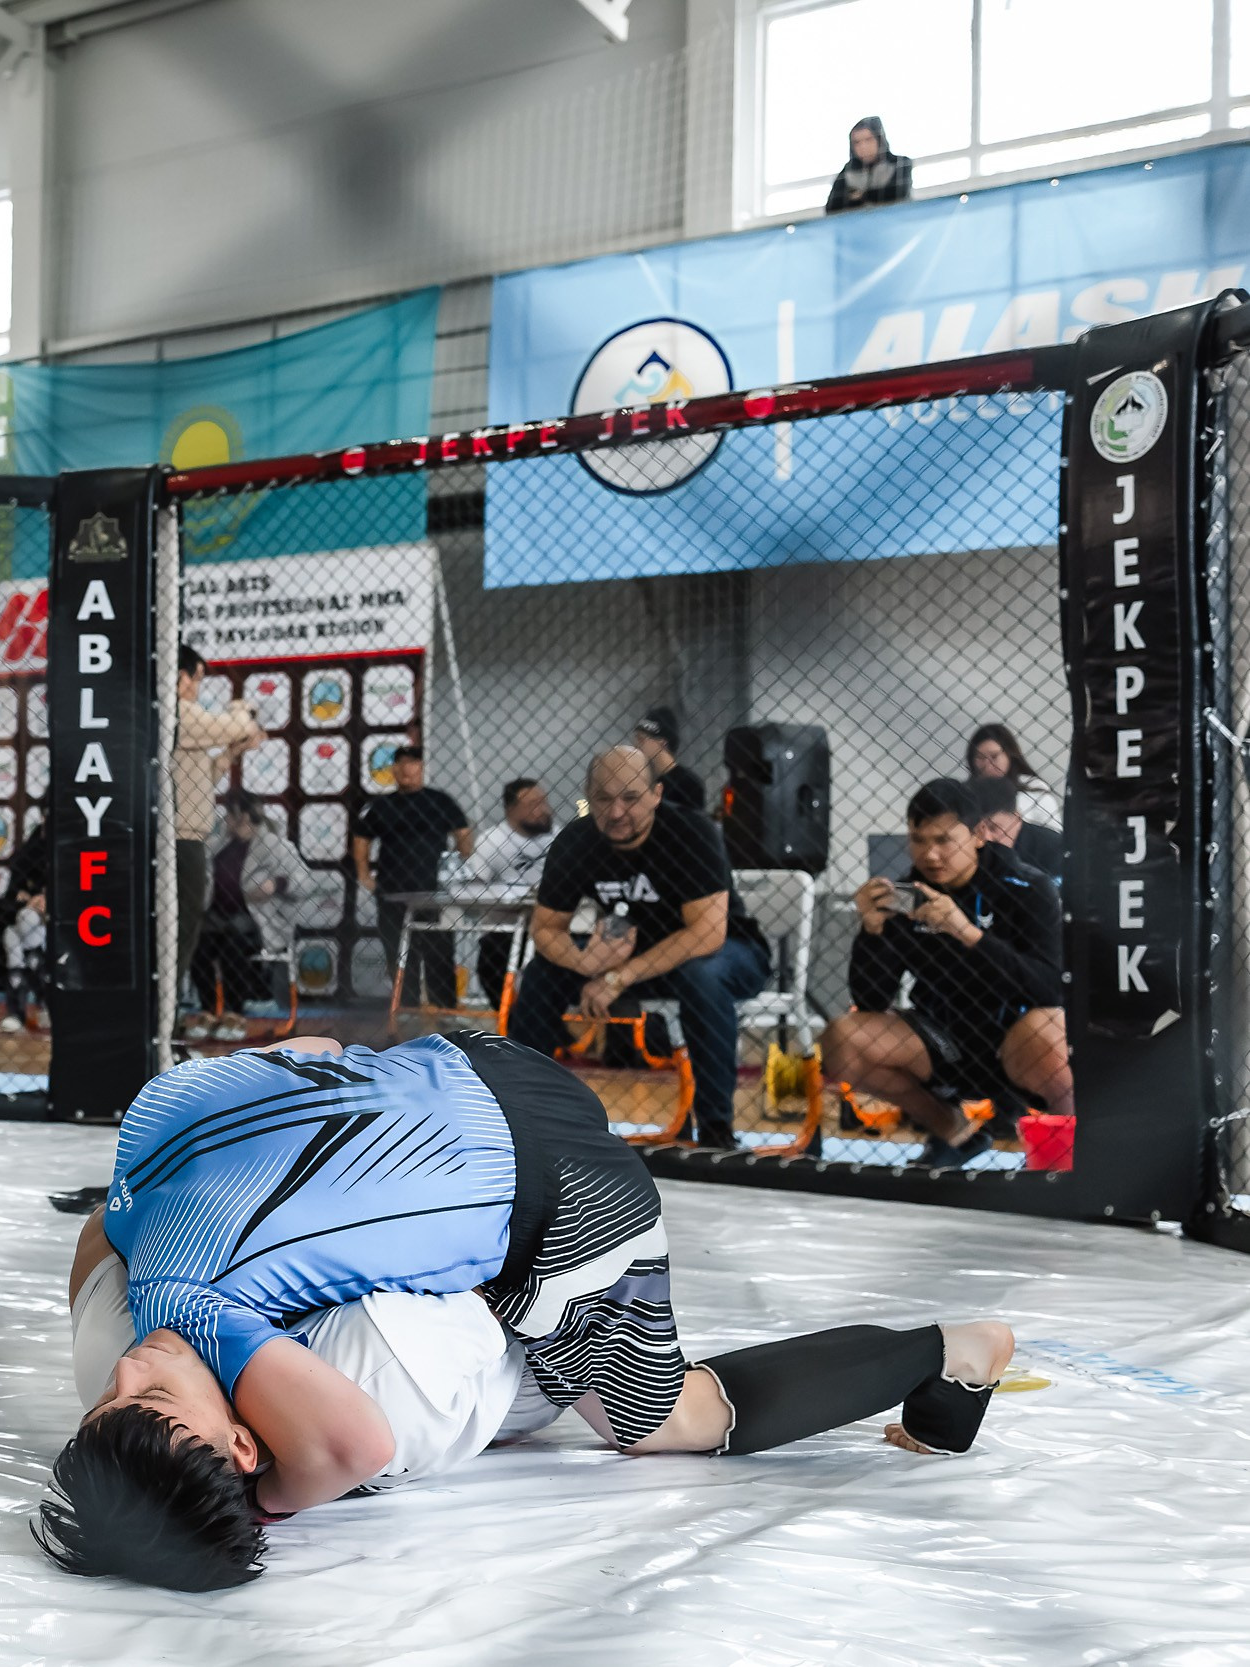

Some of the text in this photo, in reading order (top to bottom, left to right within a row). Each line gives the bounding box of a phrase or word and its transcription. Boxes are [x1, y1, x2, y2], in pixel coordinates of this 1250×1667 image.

[411, 419, 562, 467] JEKPE
[597, 399, 690, 442] JEK
[315, 618, 385, 639] REGION
[360, 589, 406, 608] MMA
[1112, 473, 1147, 779] JEKPE
[74, 579, 117, 948] ABLAY FC
[1116, 815, 1150, 994] JEK
